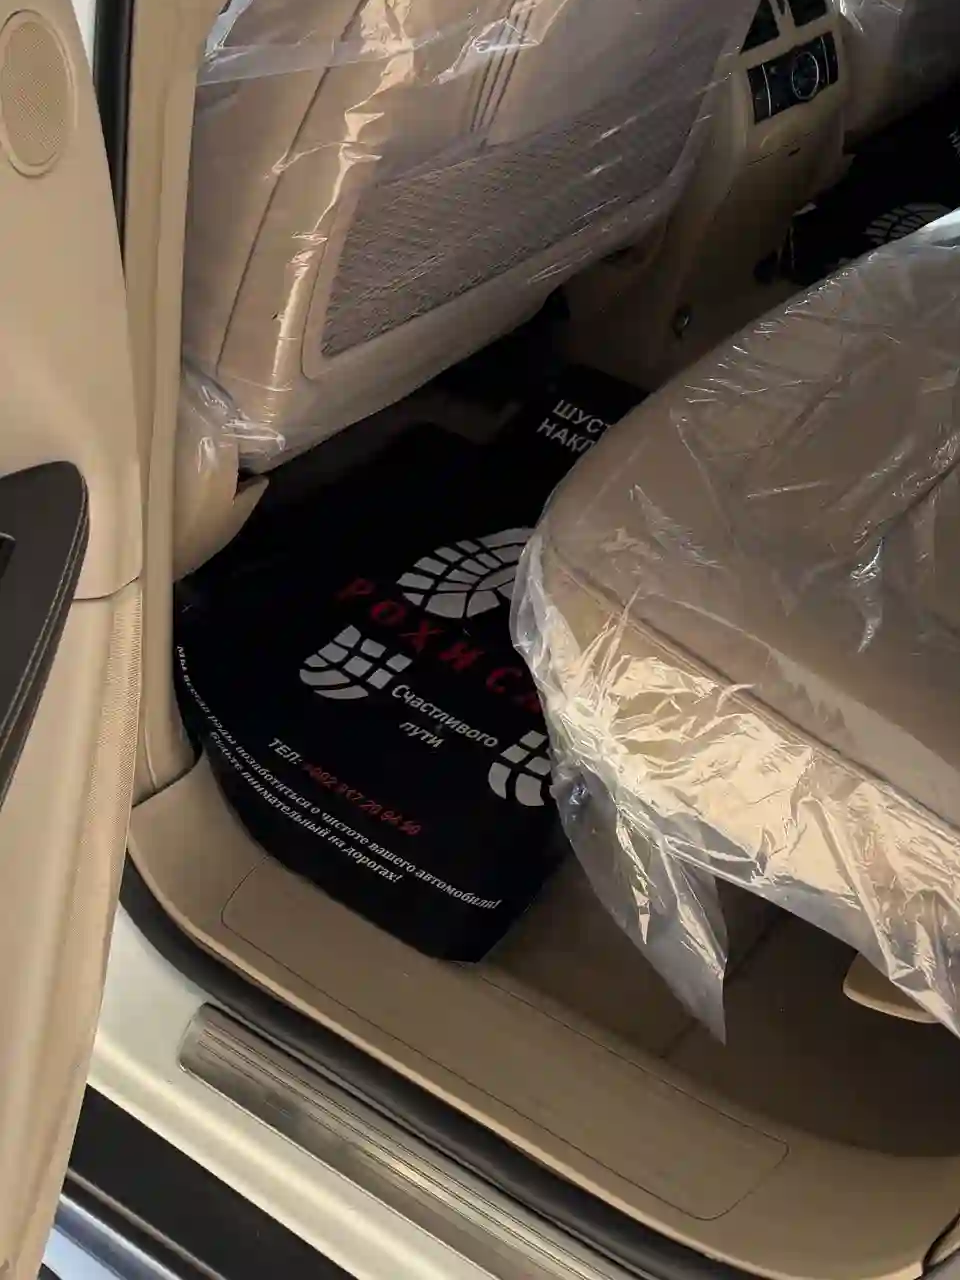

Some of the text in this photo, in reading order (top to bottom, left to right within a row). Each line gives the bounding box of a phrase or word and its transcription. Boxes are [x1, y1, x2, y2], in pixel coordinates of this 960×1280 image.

[391, 684, 498, 748] Счастливого
[235, 745, 312, 810] позаботиться
[321, 812, 369, 845] чистоте
[368, 842, 416, 873] вашего
[415, 869, 502, 909] автомобиля!
[328, 835, 346, 849] на
[341, 845, 403, 883] дорогах!
